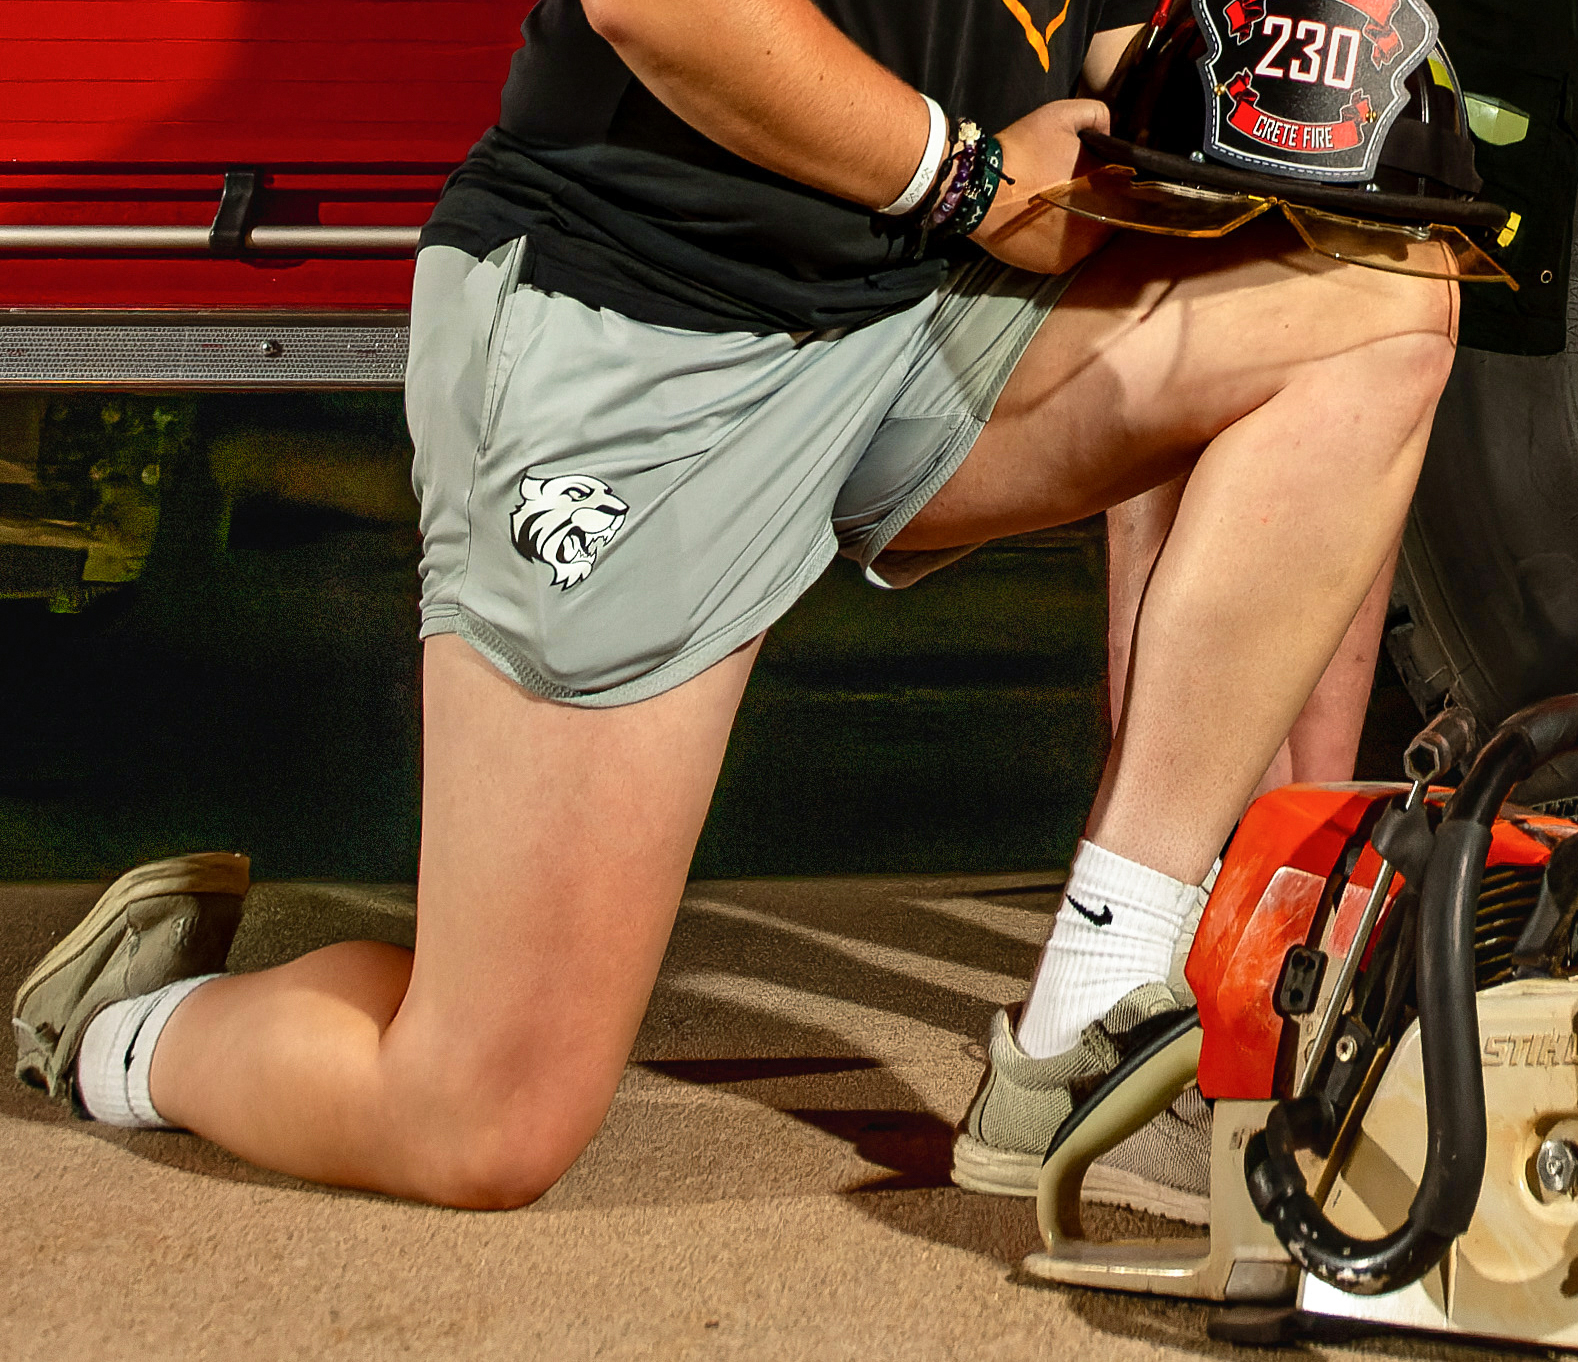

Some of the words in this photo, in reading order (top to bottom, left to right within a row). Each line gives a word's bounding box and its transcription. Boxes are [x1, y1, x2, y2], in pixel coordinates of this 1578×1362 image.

[1254, 15, 1362, 90] 230
[1252, 115, 1298, 149] CRETE
[1302, 124, 1334, 149] FIRE
